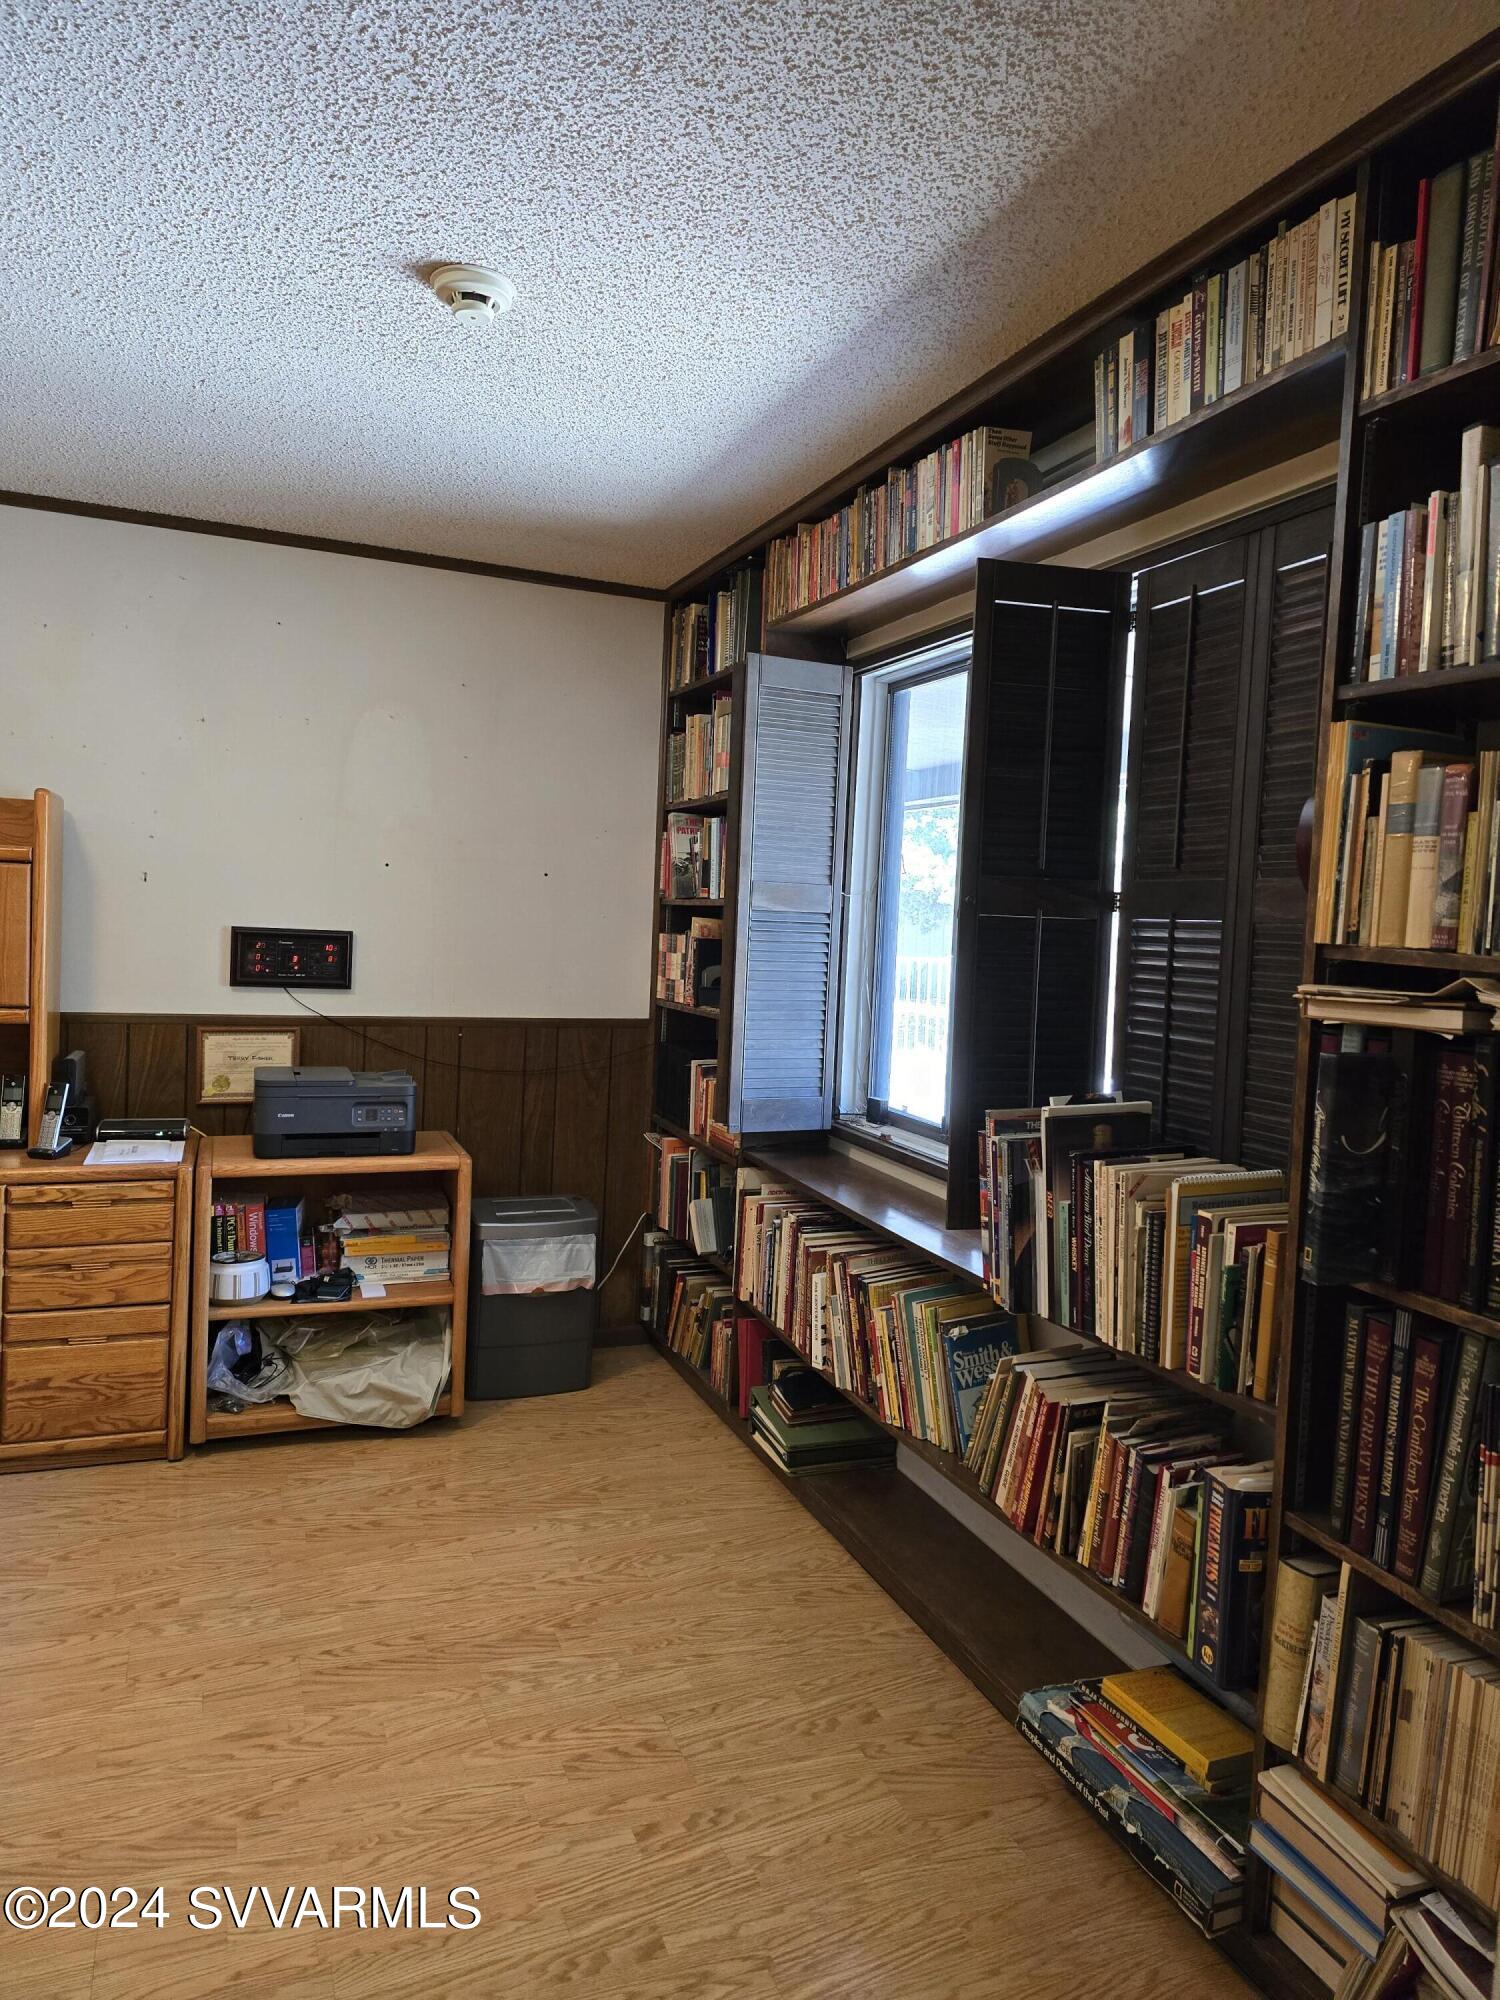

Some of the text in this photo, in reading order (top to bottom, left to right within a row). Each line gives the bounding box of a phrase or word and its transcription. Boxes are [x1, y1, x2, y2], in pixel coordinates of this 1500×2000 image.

[1340, 209, 1351, 229] MY
[1308, 231, 1317, 263] FANNY
[1338, 232, 1350, 278] SECRET
[1455, 158, 1482, 351] AND CONQUEST OF MEXICO
[1306, 265, 1315, 289] HILL
[1337, 280, 1348, 309] LIFE
[1193, 356, 1201, 393] WRATH
[1446, 1102, 1472, 1220] Thirteen Colonies
[1083, 1168, 1093, 1212] American
[227, 1217, 236, 1231] PCs
[1083, 1213, 1092, 1235] Bird
[953, 1340, 1013, 1369] Smith &
[954, 1362, 997, 1390] Wess
[1334, 1317, 1358, 1508] MATHEW BRADY AND HIS WORLD
[1385, 1374, 1402, 1435] RAILROADS
[1007, 1424, 1020, 1467] GUNSMITHING
[1117, 1456, 1125, 1472] Gun
[1352, 1364, 1380, 1529] THE GREAT WEST
[1402, 1386, 1430, 1522] The Confident Years
[1434, 1390, 1470, 1523] Automobile in America
[1001, 1469, 1010, 1489] GUIDE
[1379, 1445, 1395, 1497] AMERICA
[1110, 1500, 1119, 1520] Book
[1081, 1684, 1138, 1733] BAJA CALIFORNIA
[1021, 1721, 1109, 1821] Peoples and Places of the Past
